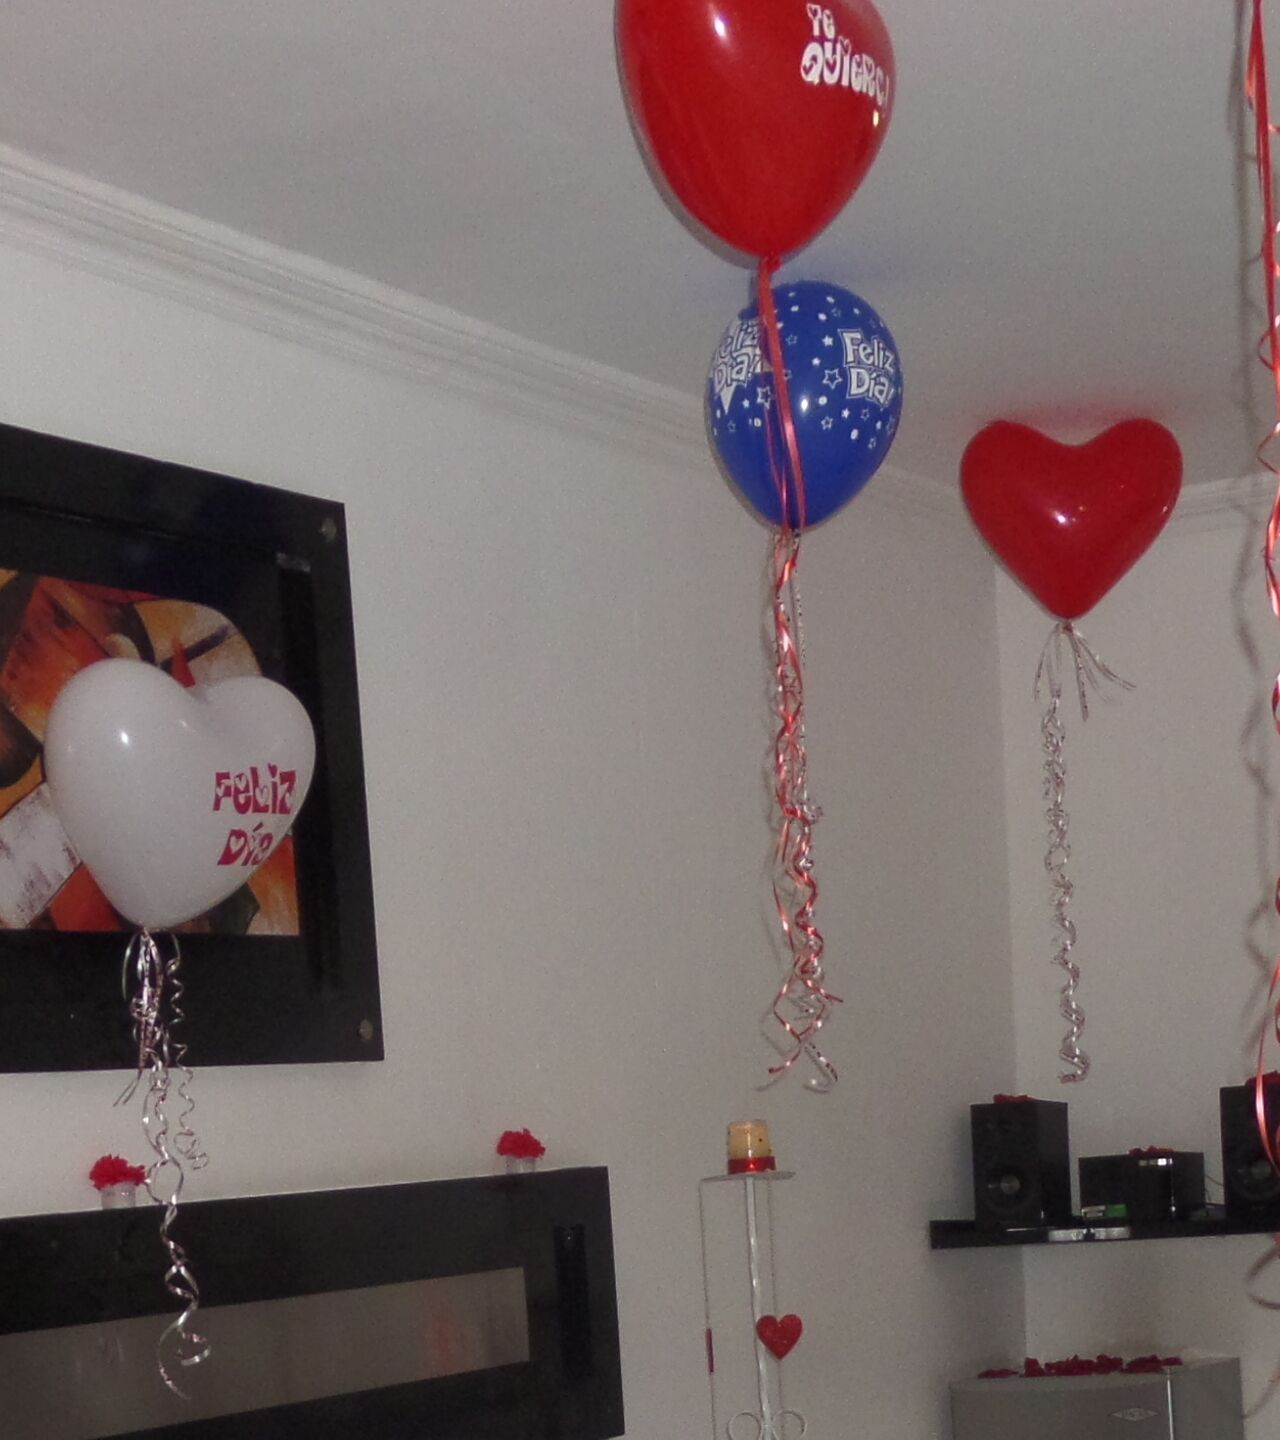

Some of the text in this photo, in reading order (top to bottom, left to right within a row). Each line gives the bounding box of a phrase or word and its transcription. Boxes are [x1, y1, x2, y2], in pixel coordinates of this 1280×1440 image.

[715, 321, 763, 368] eliz
[842, 331, 895, 374] Feliz
[849, 367, 896, 405] Día!
